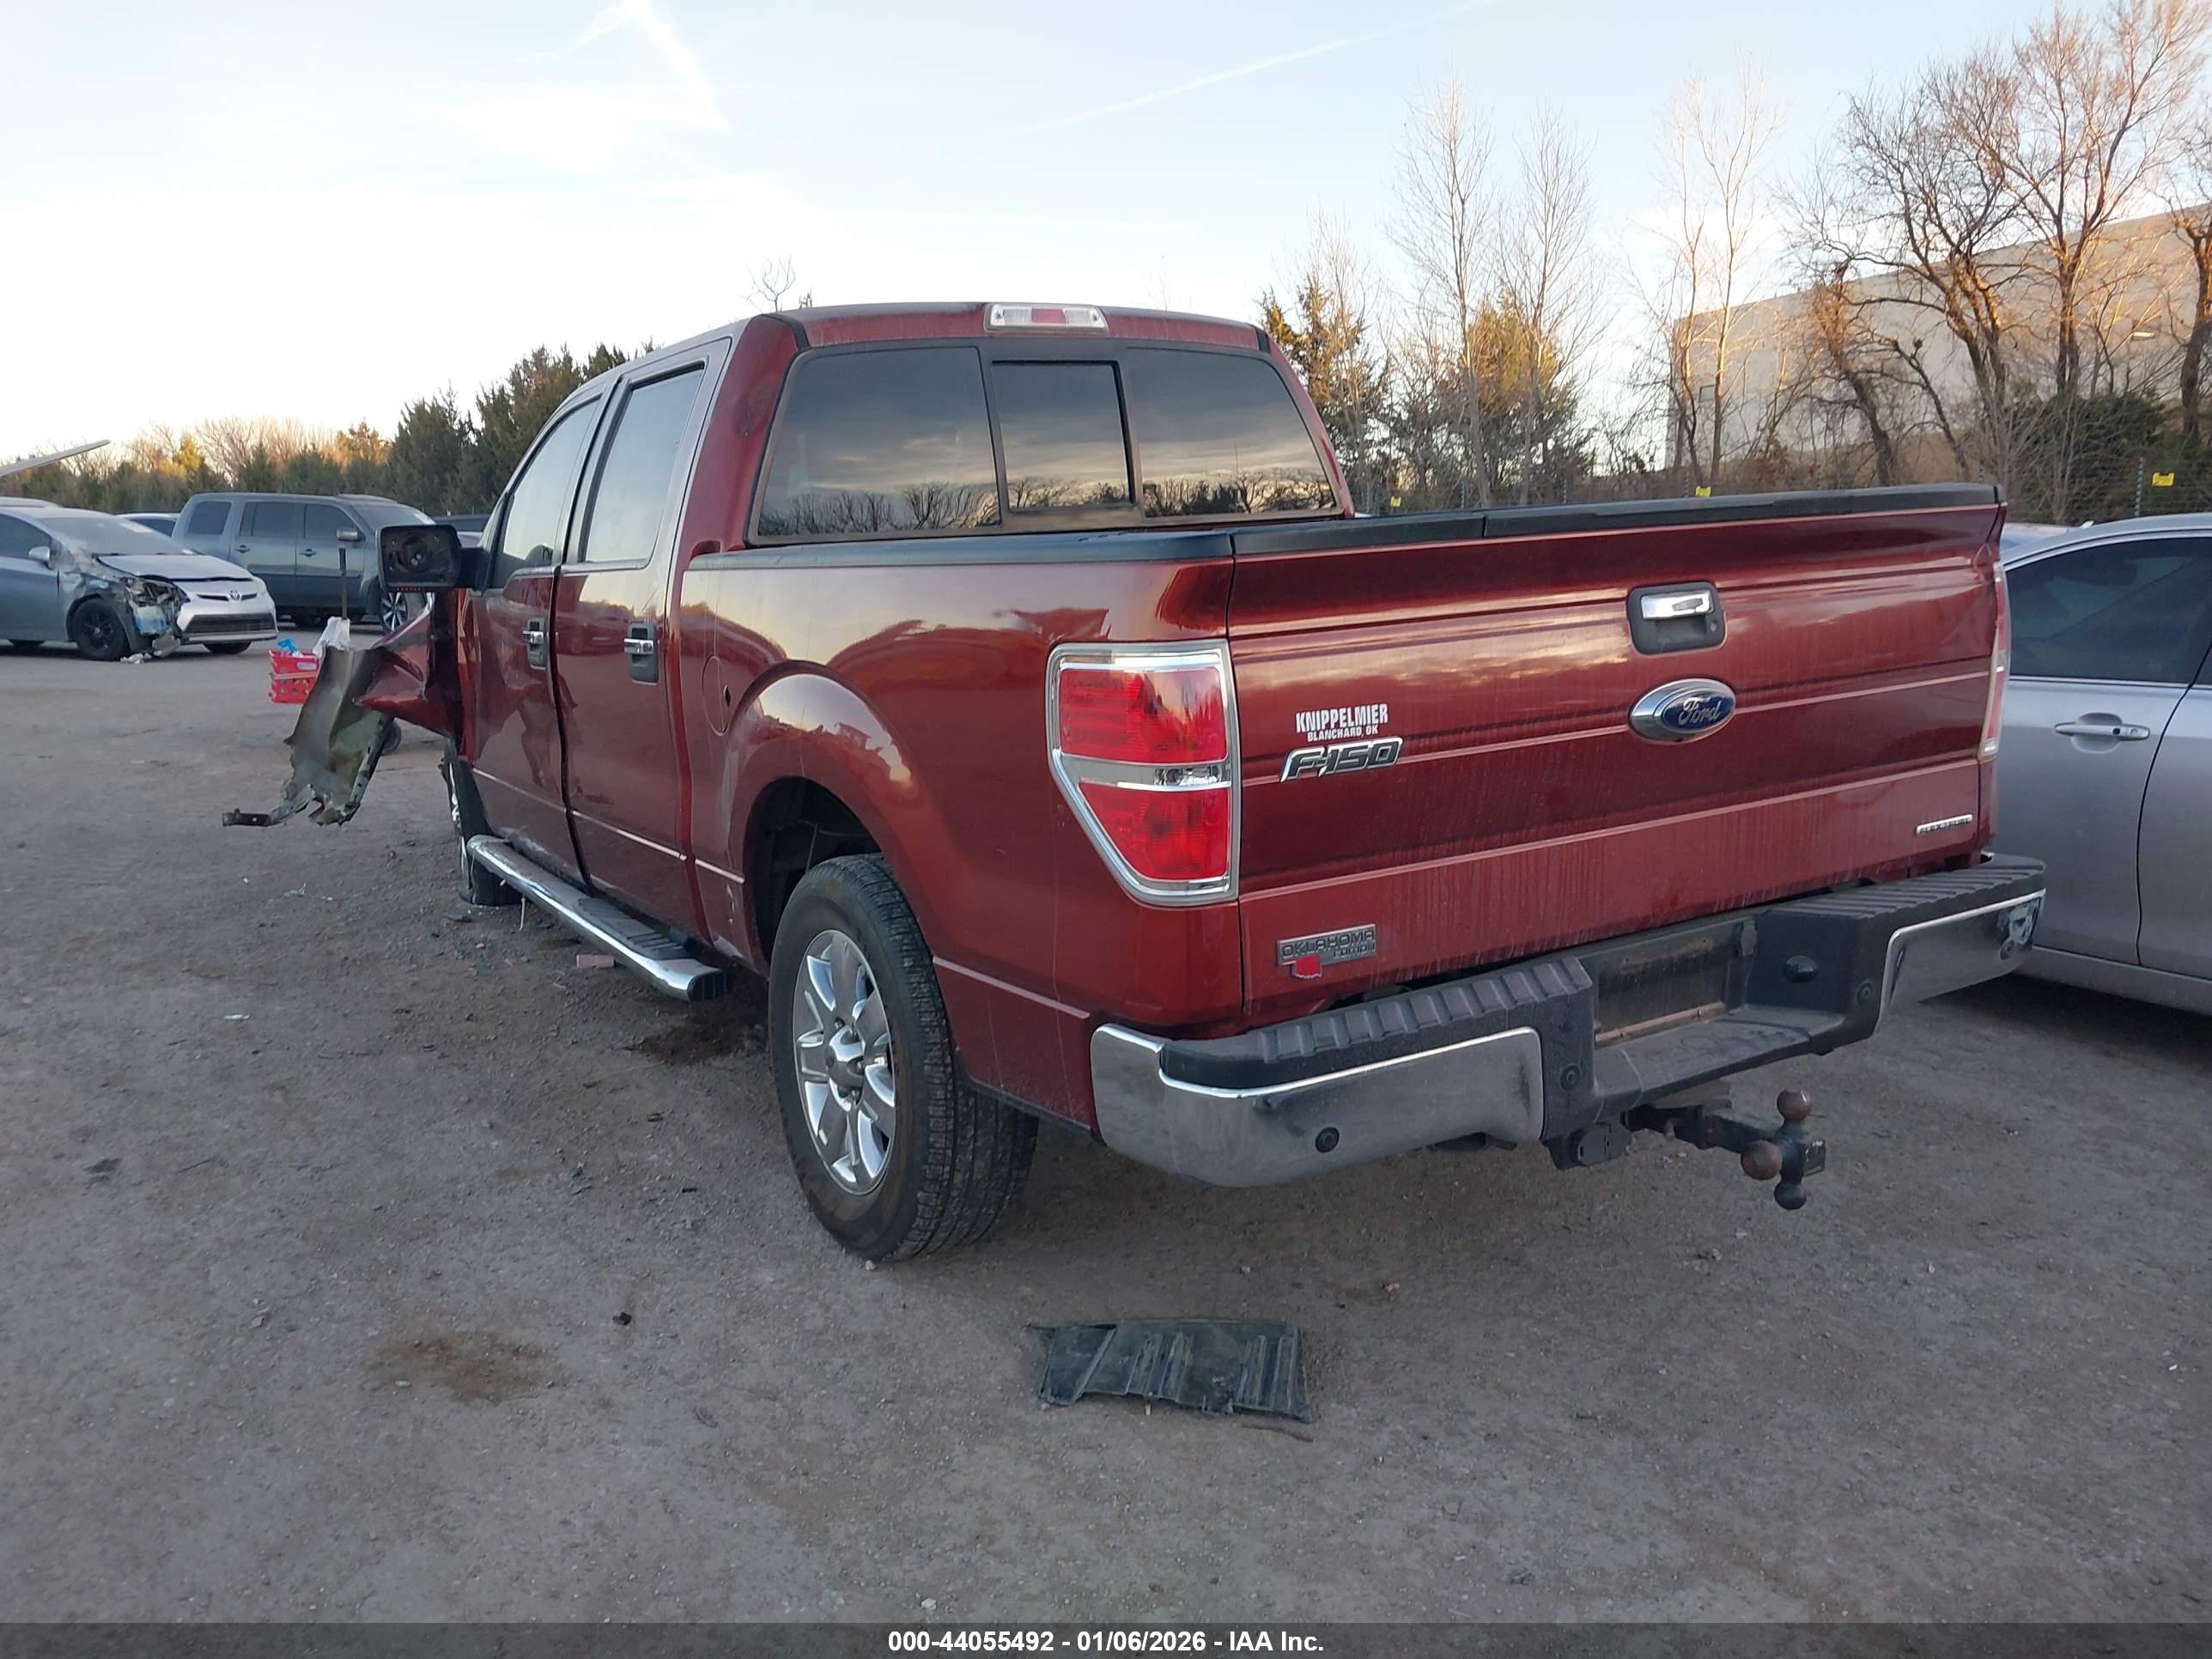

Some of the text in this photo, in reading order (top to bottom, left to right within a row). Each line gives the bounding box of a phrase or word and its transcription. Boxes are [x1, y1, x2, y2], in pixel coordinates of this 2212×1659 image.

[1296, 704, 1389, 732] KNIPPELMIER
[1678, 696, 1723, 726] Ford
[1308, 726, 1378, 742] BLANCHARD, OK
[1280, 736, 1403, 782] F-150
[1282, 929, 1375, 957] OKLAHOMA
